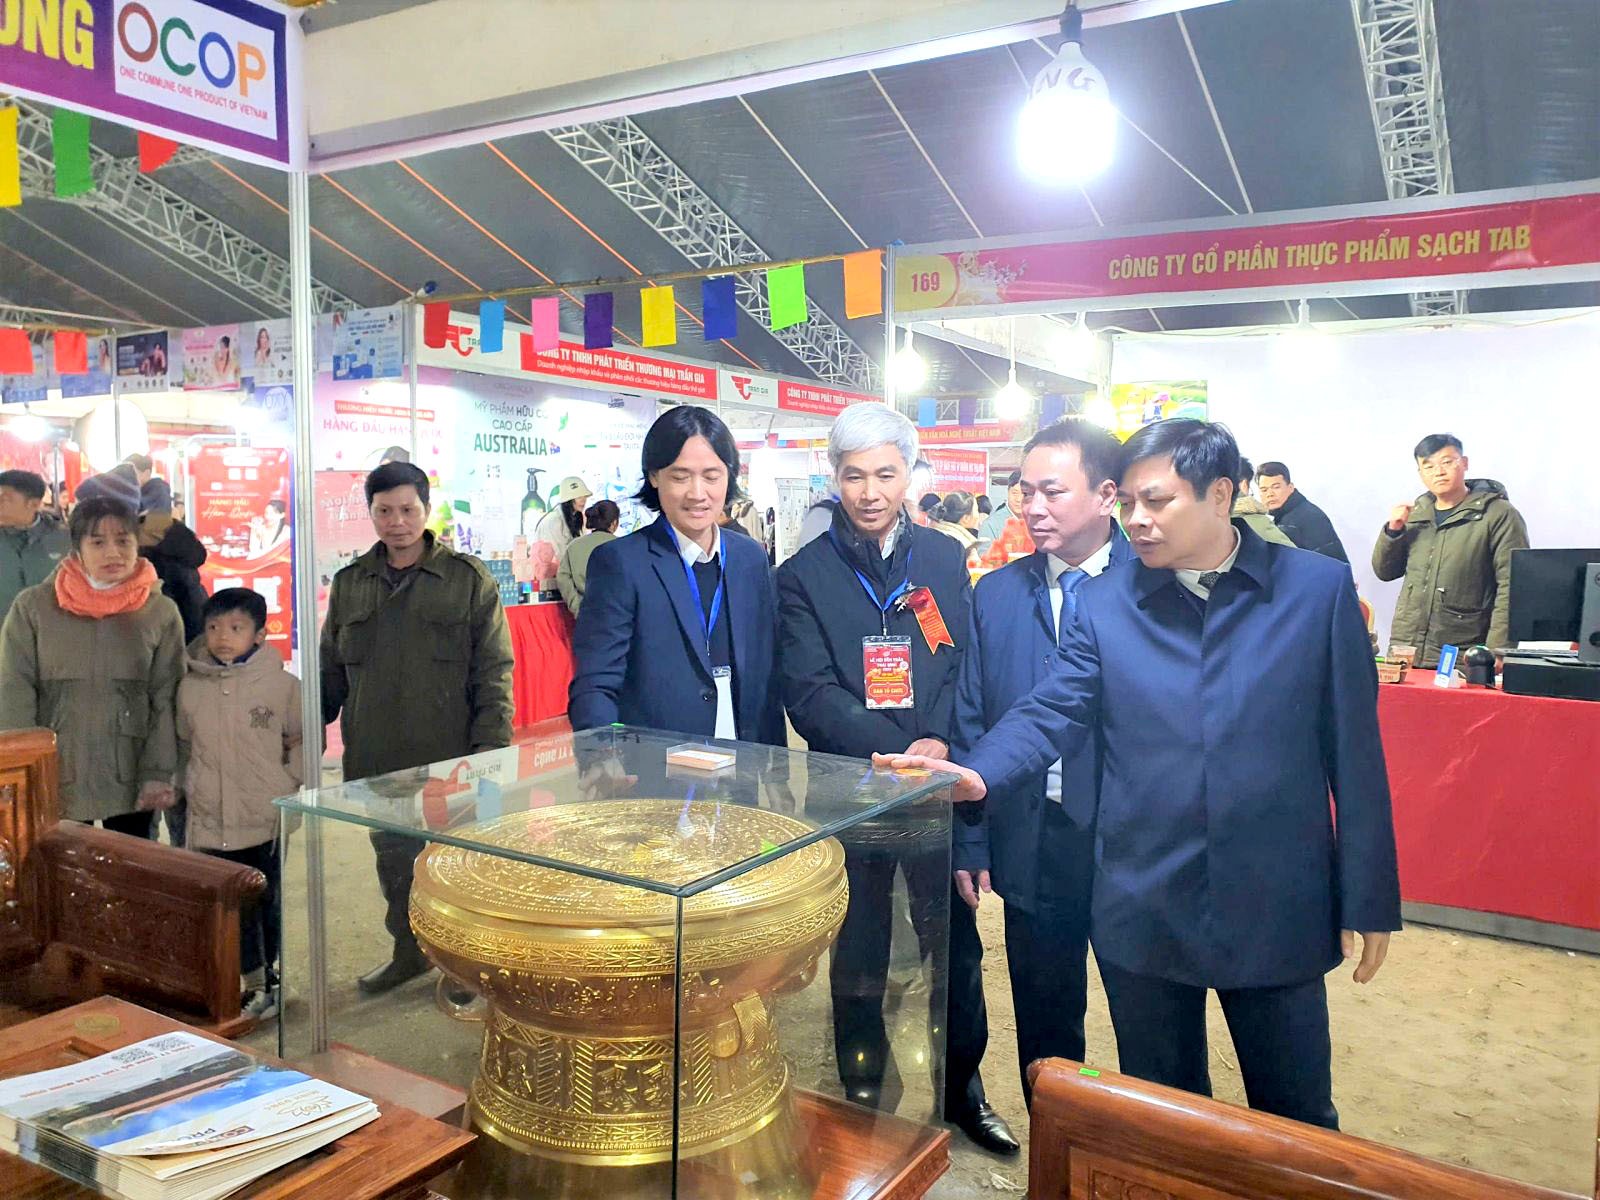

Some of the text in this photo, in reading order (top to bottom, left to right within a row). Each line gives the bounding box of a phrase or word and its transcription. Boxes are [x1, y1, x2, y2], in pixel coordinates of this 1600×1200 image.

[117, 2, 266, 97] OCOP
[120, 66, 268, 120] ONE COMMUNE ONE PRODUCT OF VIETNAM
[1108, 224, 1531, 280] CÔNG TY CỔ PHẦN THỰC PHẨM SẠCH TAB
[911, 271, 940, 293] 169
[467, 337, 480, 346] TRA
[537, 348, 559, 359] NG
[561, 348, 570, 361] TY
[572, 350, 592, 365] TNHH
[594, 354, 612, 368] PHÁT
[663, 367, 676, 381] MẠI
[694, 373, 705, 384] GIA
[474, 401, 488, 412] MỸ
[516, 404, 534, 418] HỮU
[323, 416, 358, 433] HÀNG
[492, 419, 533, 433] CAO CẤP
[474, 433, 548, 456] AUSTRALIA
